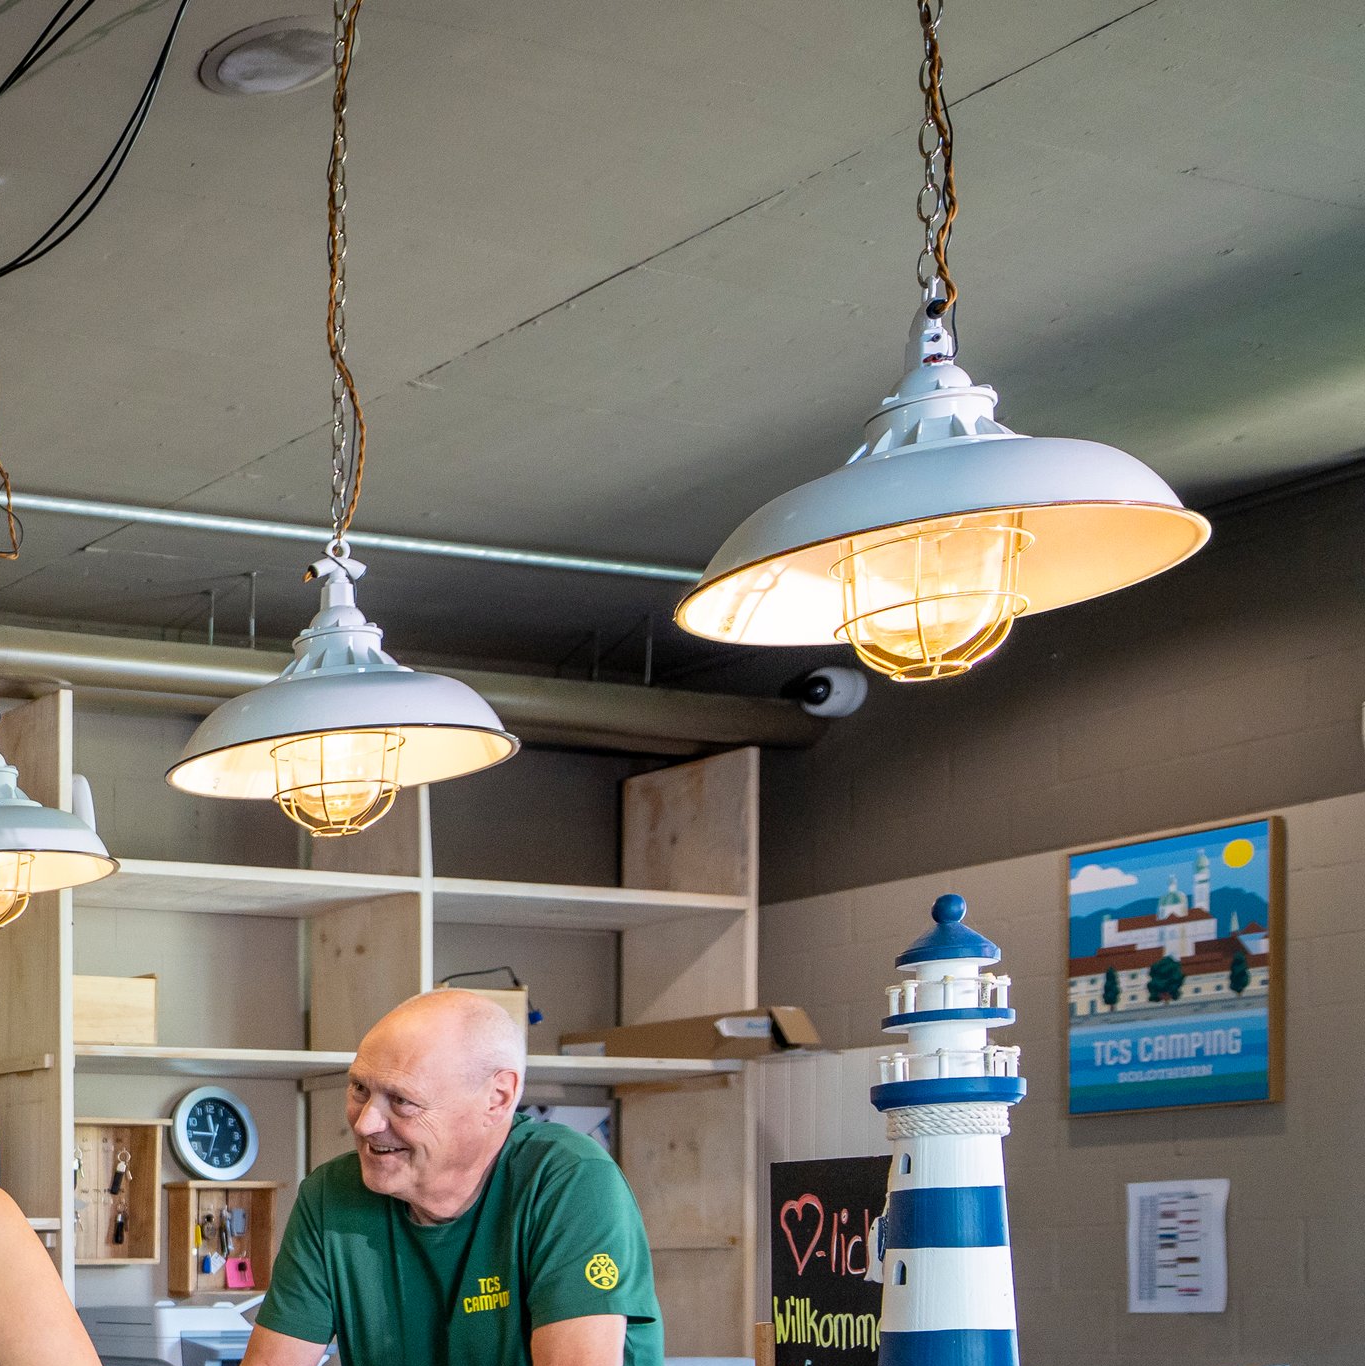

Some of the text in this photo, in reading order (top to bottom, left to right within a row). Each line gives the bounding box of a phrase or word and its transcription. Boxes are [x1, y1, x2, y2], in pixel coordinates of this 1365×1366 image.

[1093, 1028, 1242, 1067] TCS CAMPING
[478, 1276, 502, 1294] TCS
